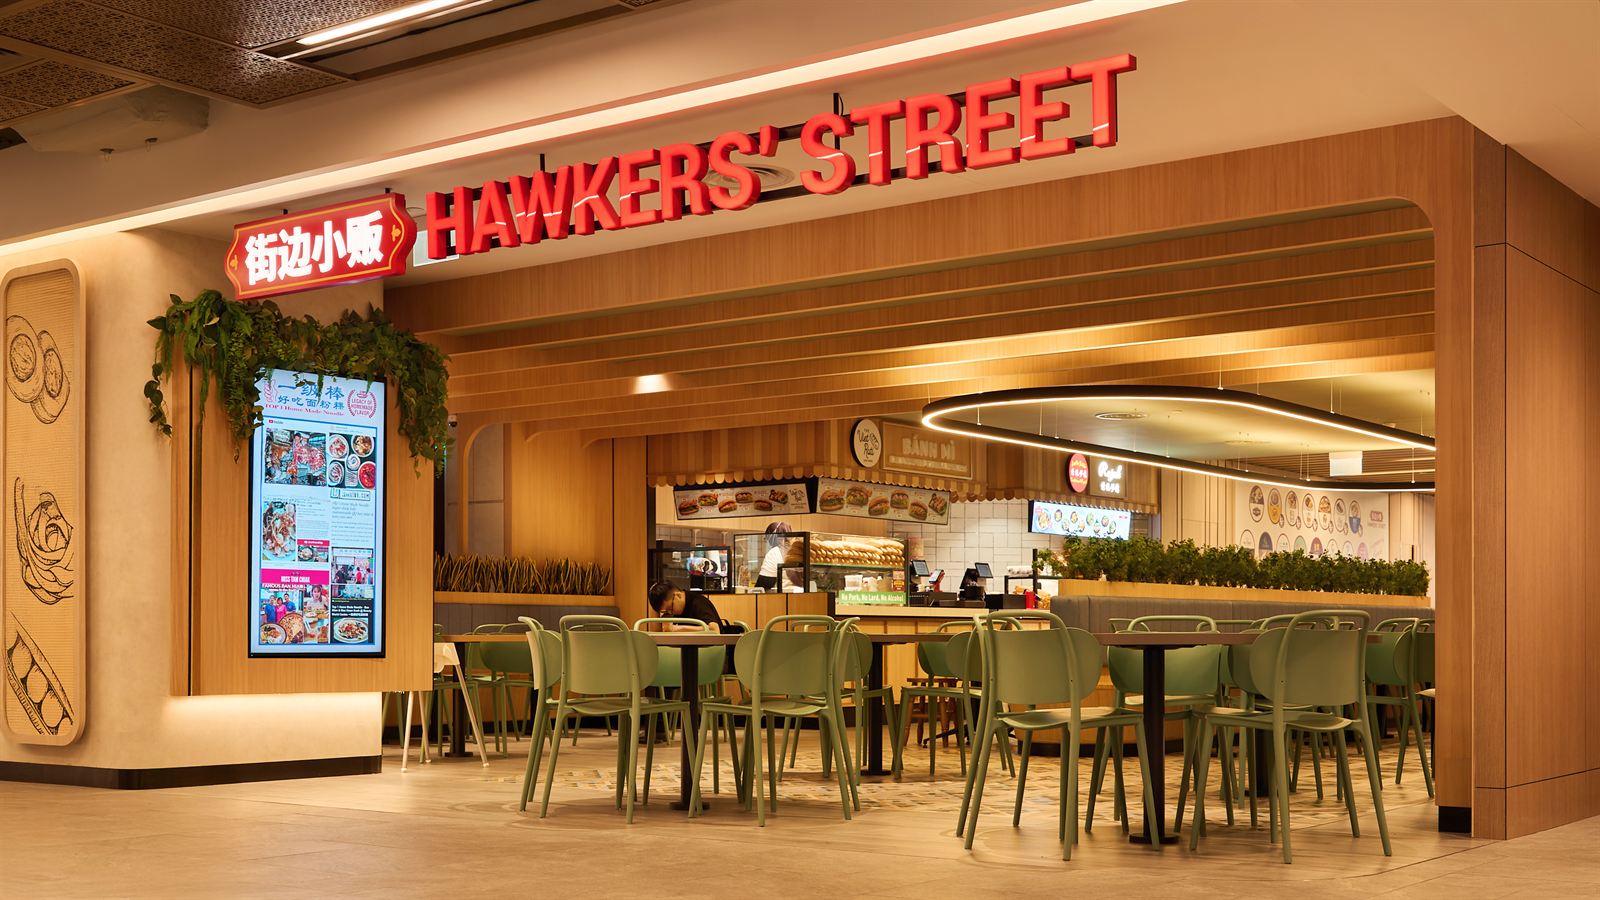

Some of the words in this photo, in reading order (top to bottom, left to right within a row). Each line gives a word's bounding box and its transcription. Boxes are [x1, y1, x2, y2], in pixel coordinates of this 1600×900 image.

[426, 124, 779, 260] HAWKERS'
[800, 53, 1137, 195] STREET
[245, 210, 384, 285] 街边小贩
